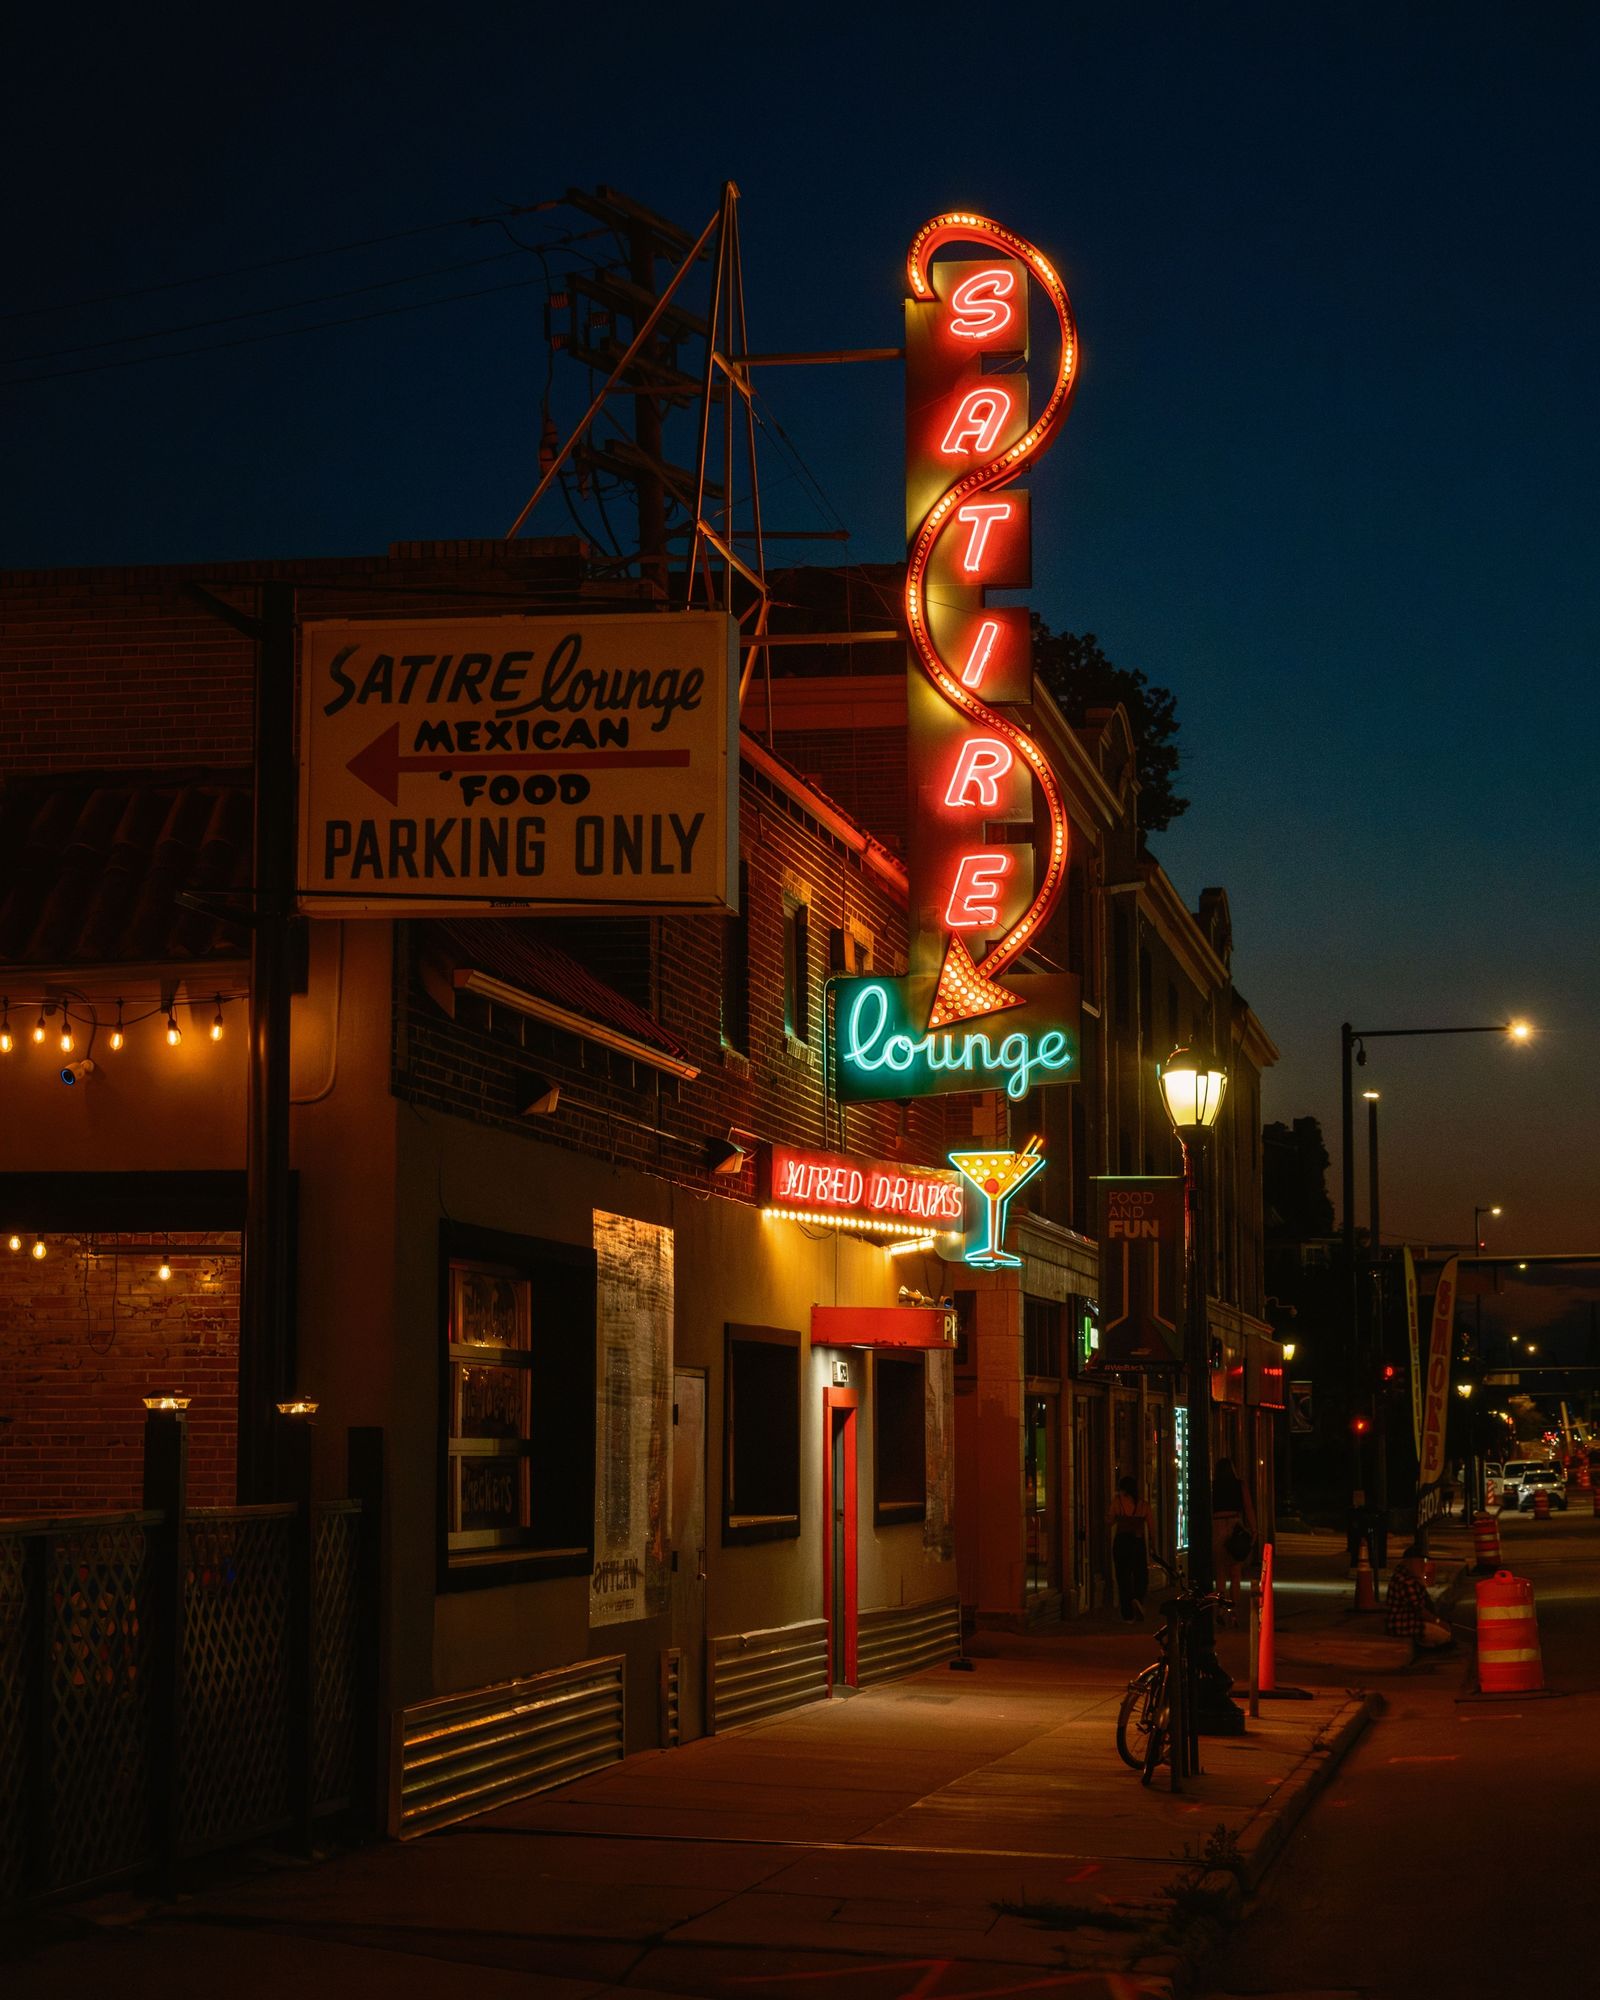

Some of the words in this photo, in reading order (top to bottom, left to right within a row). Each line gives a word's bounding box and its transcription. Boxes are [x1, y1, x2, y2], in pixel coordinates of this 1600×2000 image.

[941, 269, 1015, 927] SATIRE
[323, 643, 535, 718] SATIRE
[495, 633, 706, 732] lounge
[413, 717, 630, 753] MEXICAN
[459, 774, 592, 807] FOOD
[324, 816, 546, 880] PARKING
[574, 813, 706, 876] ONLY
[843, 984, 1073, 1099] lounge
[779, 1160, 864, 1205] MIXED
[874, 1176, 964, 1218] DRINKS
[1107, 1191, 1155, 1205] FOOD
[1107, 1206, 1145, 1219] AND
[1107, 1220, 1160, 1238] FUN
